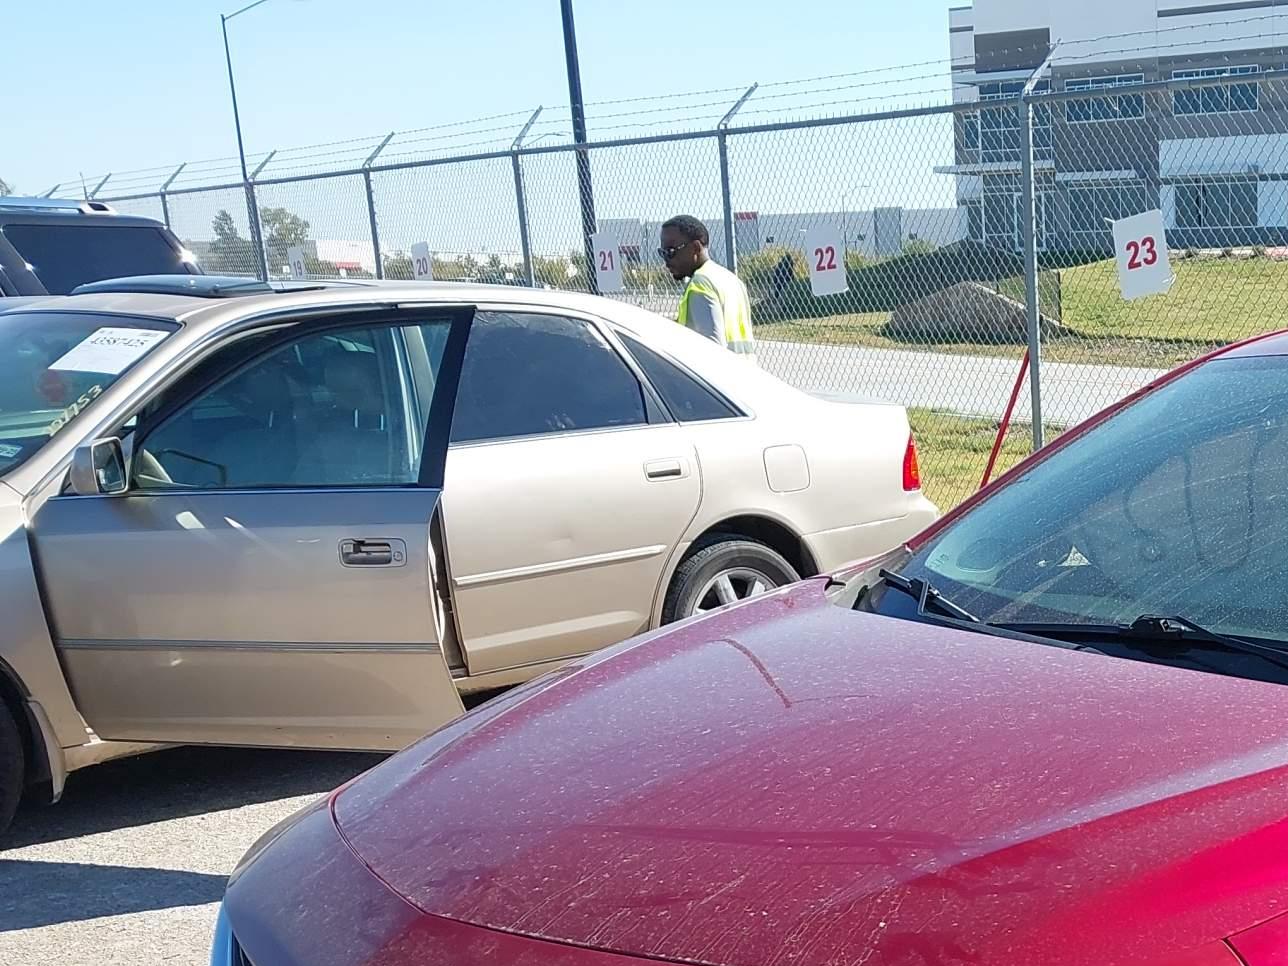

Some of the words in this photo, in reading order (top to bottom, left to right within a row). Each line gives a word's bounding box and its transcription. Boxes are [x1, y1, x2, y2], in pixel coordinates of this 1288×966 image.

[599, 250, 615, 271] 21
[814, 245, 837, 272] 22
[1126, 236, 1158, 270] 23
[416, 257, 428, 276] 20
